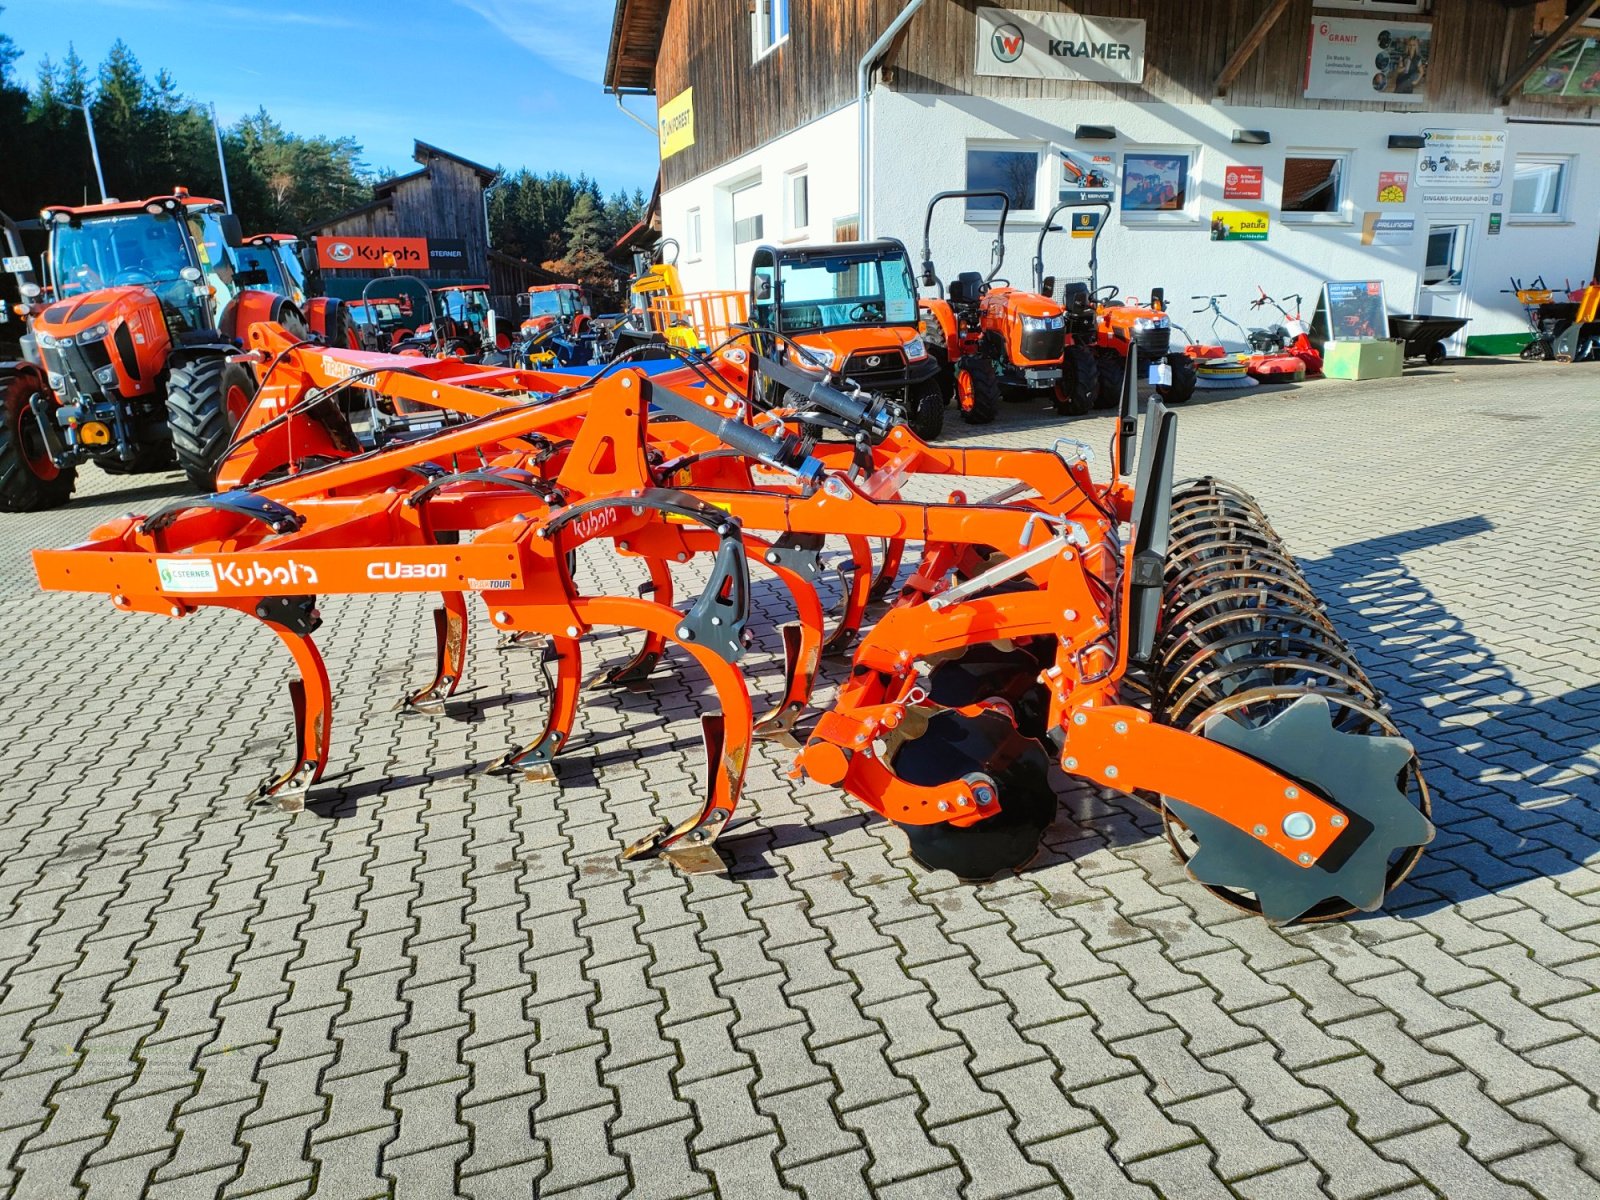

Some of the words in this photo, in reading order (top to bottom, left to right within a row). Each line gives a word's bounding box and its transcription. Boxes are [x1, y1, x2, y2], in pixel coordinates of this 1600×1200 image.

[1328, 34, 1358, 43] GRANIT
[1048, 39, 1131, 60] KRAMER
[1240, 221, 1267, 231] patura
[430, 250, 462, 258] STERNER
[216, 559, 318, 587] Kubota
[366, 562, 448, 579] CU3301
